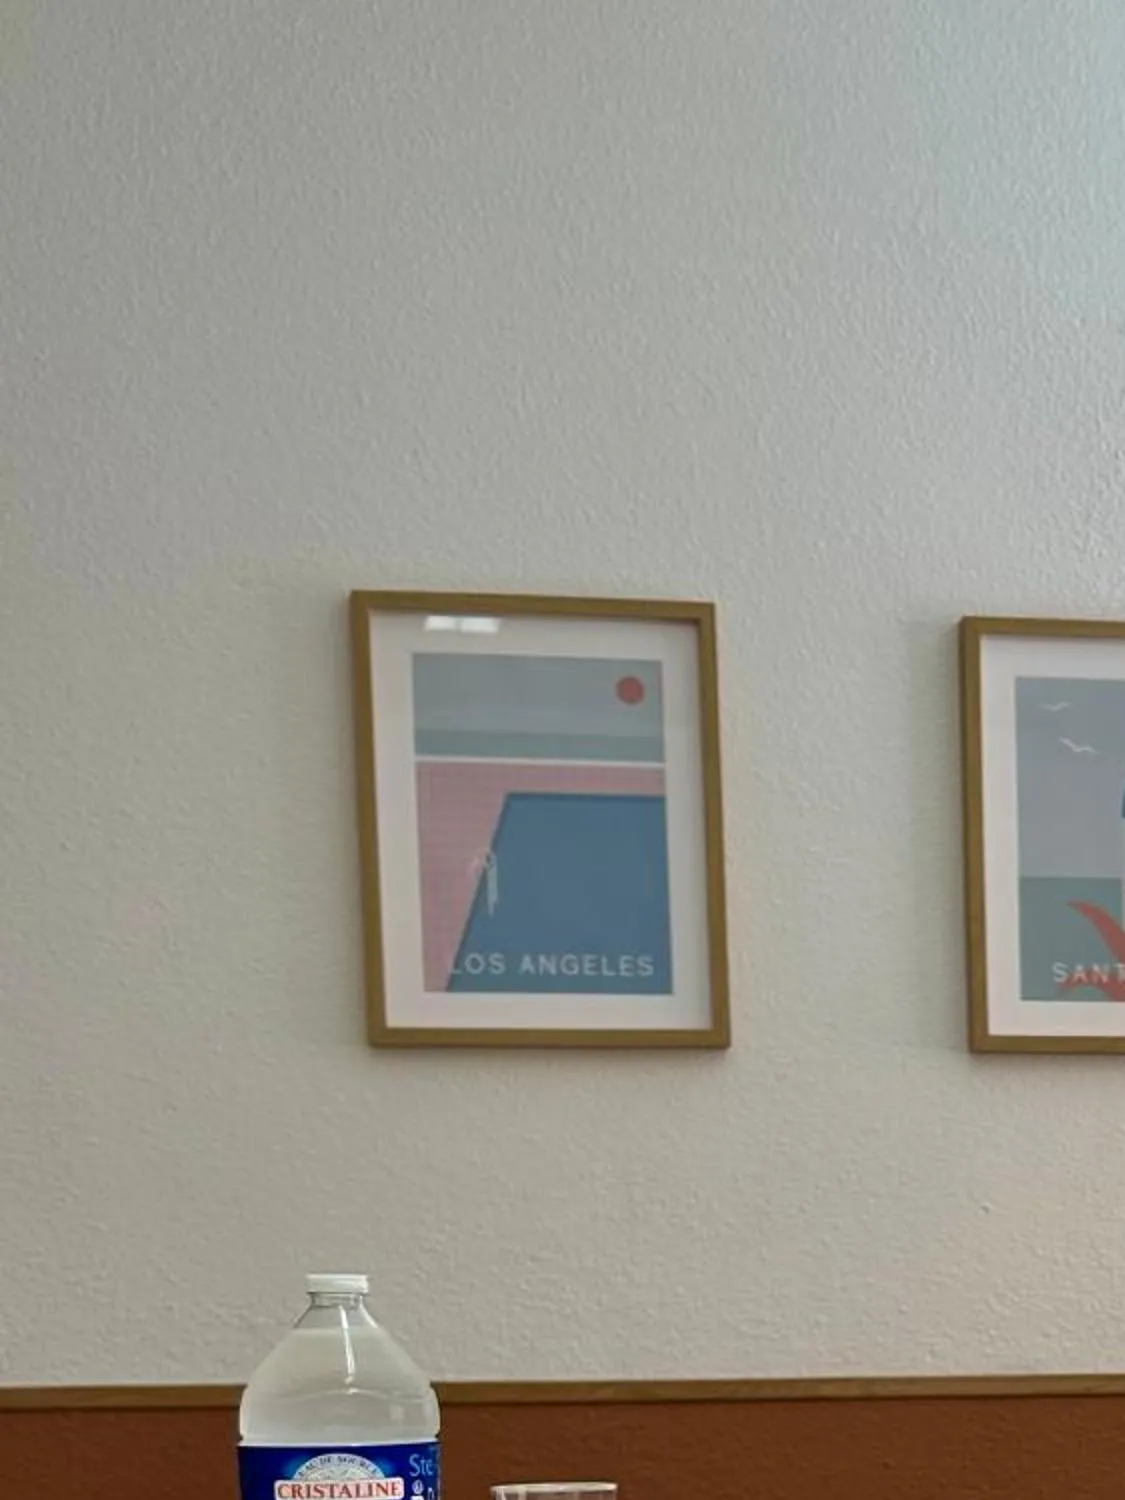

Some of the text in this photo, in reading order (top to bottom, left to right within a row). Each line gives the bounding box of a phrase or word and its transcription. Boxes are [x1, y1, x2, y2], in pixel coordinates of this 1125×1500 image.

[449, 952, 655, 977] LOS ANGELES
[278, 1481, 401, 1500] CRISTALINE
